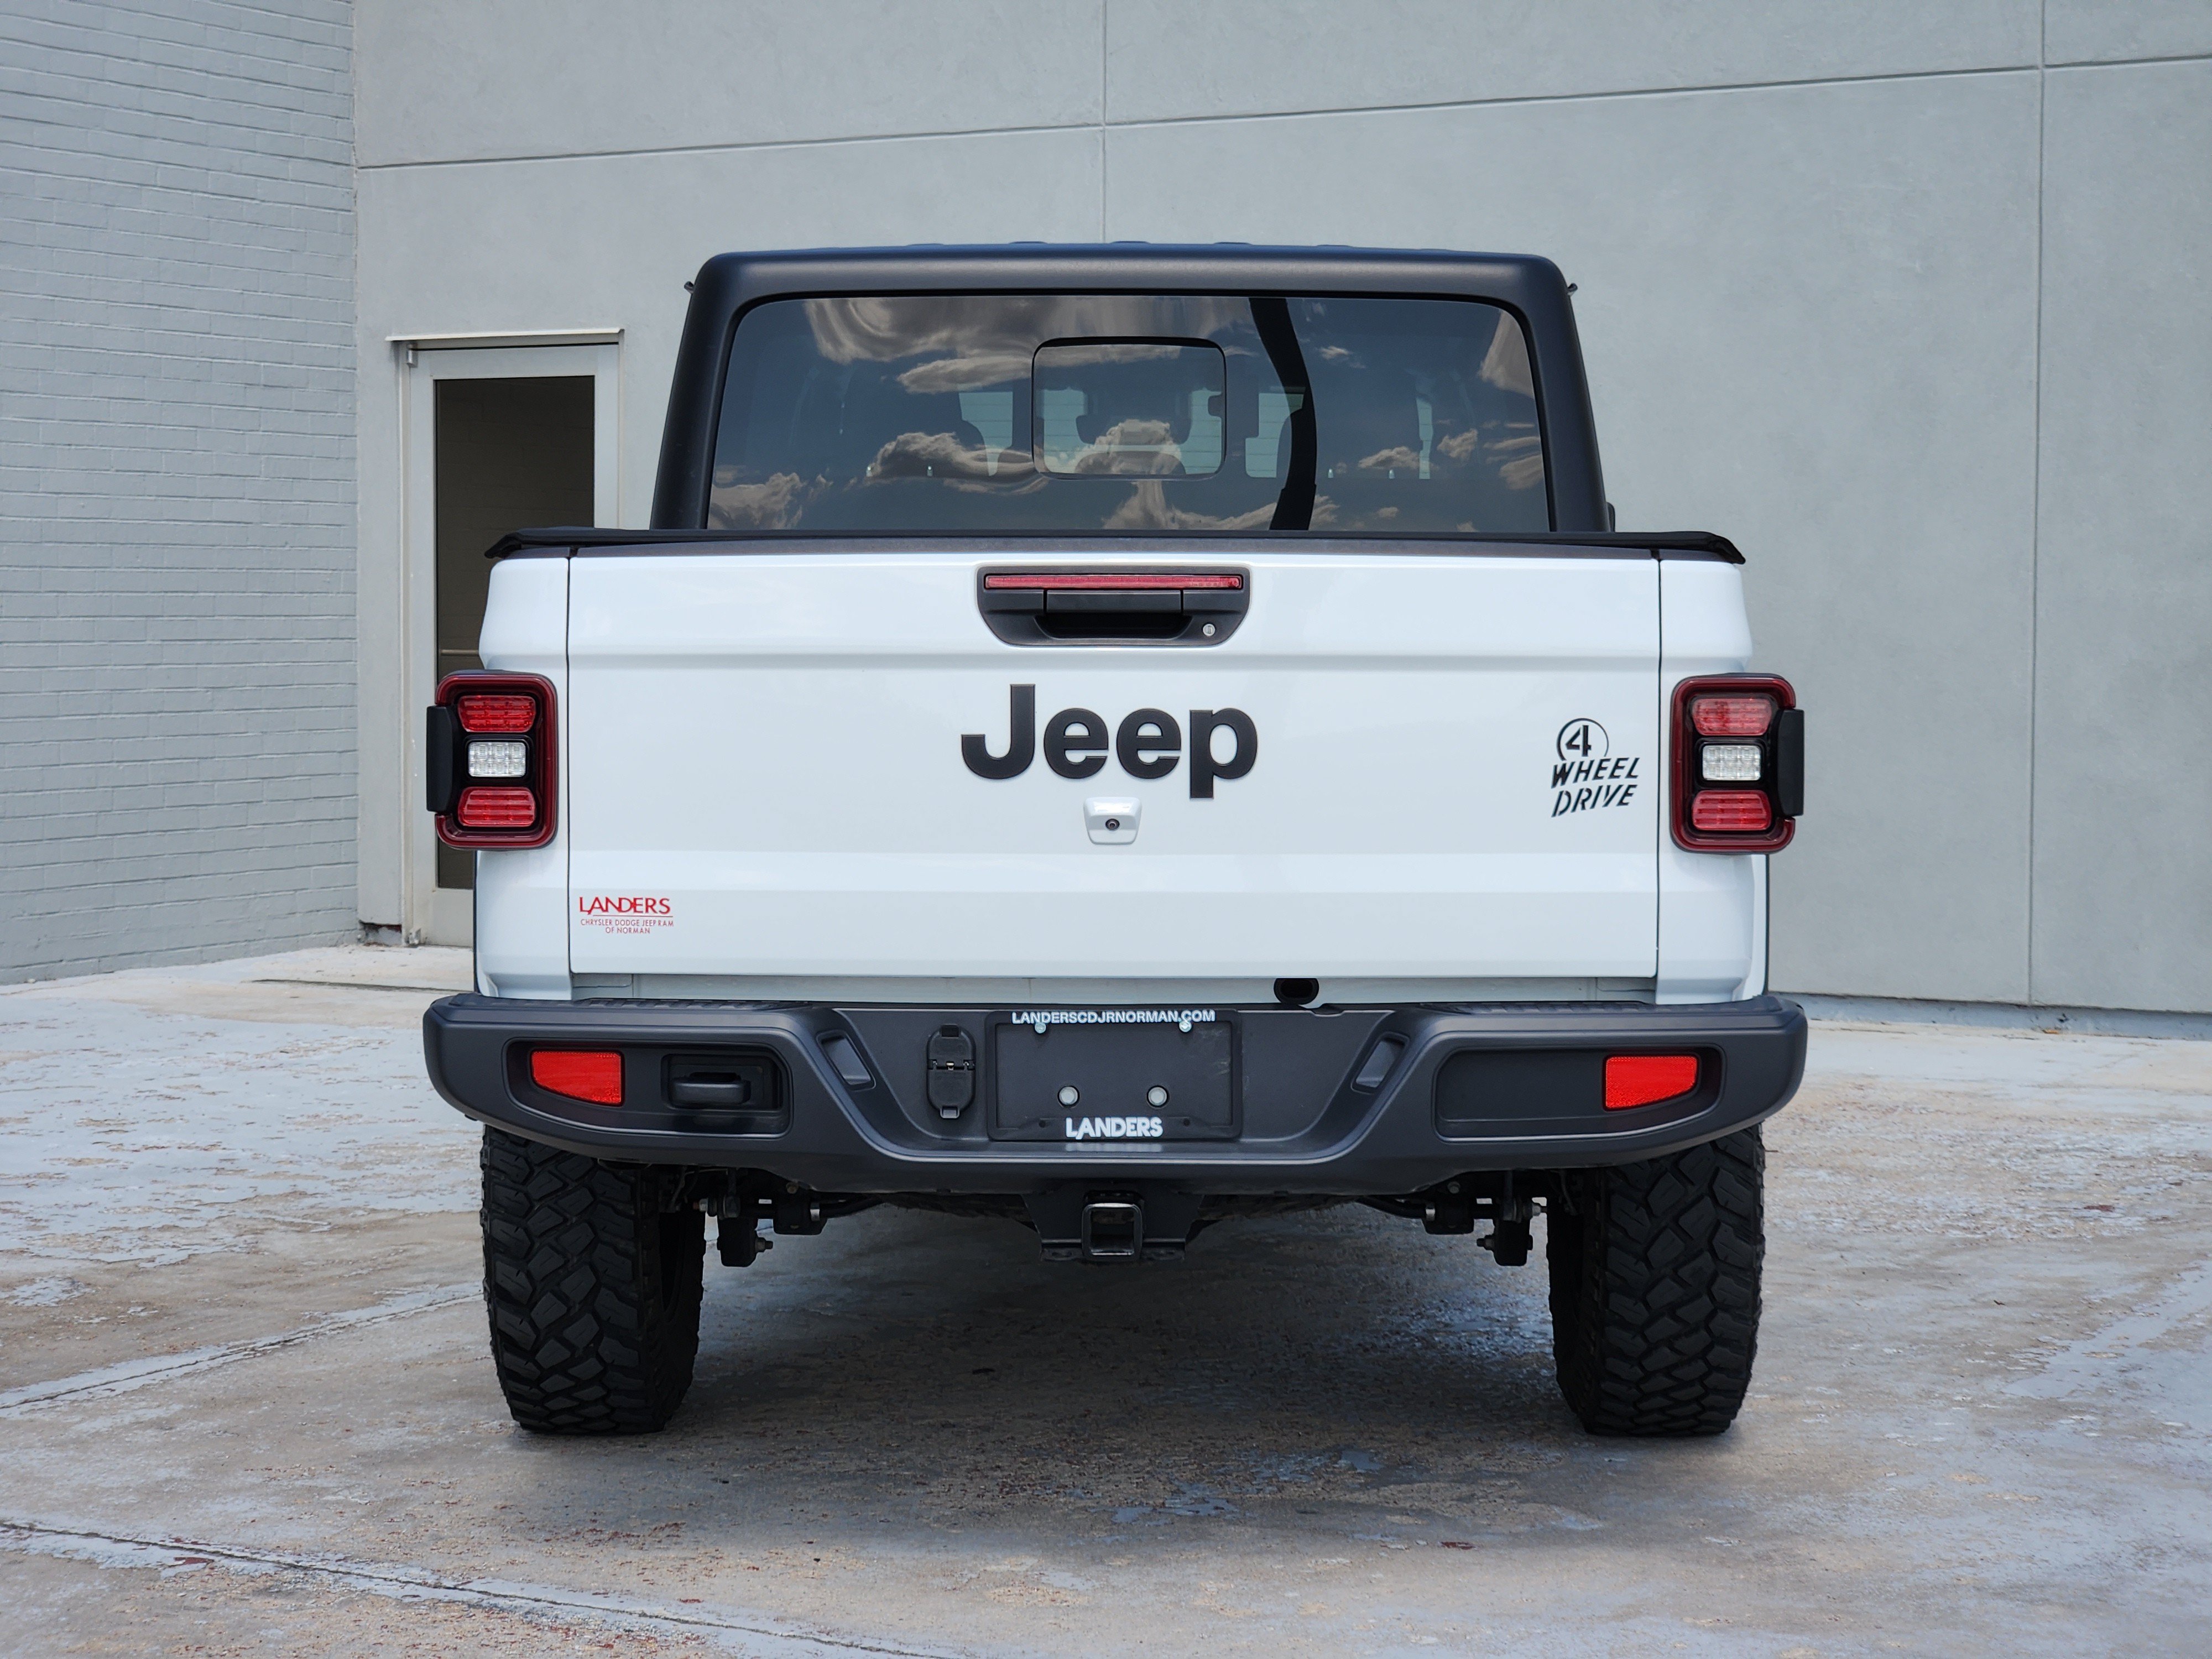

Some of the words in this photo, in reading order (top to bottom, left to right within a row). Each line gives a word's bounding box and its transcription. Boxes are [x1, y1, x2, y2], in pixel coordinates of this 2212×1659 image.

[961, 683, 1258, 800] Jeep
[1564, 724, 1592, 757] 4
[1551, 757, 1640, 789] WHEEL
[1551, 784, 1638, 818] DRIVE
[579, 896, 671, 915] LANDERS
[1011, 1010, 1215, 1024] LANDERSCDJRNORMAN.COM
[1066, 1116, 1164, 1140] LANDERS
